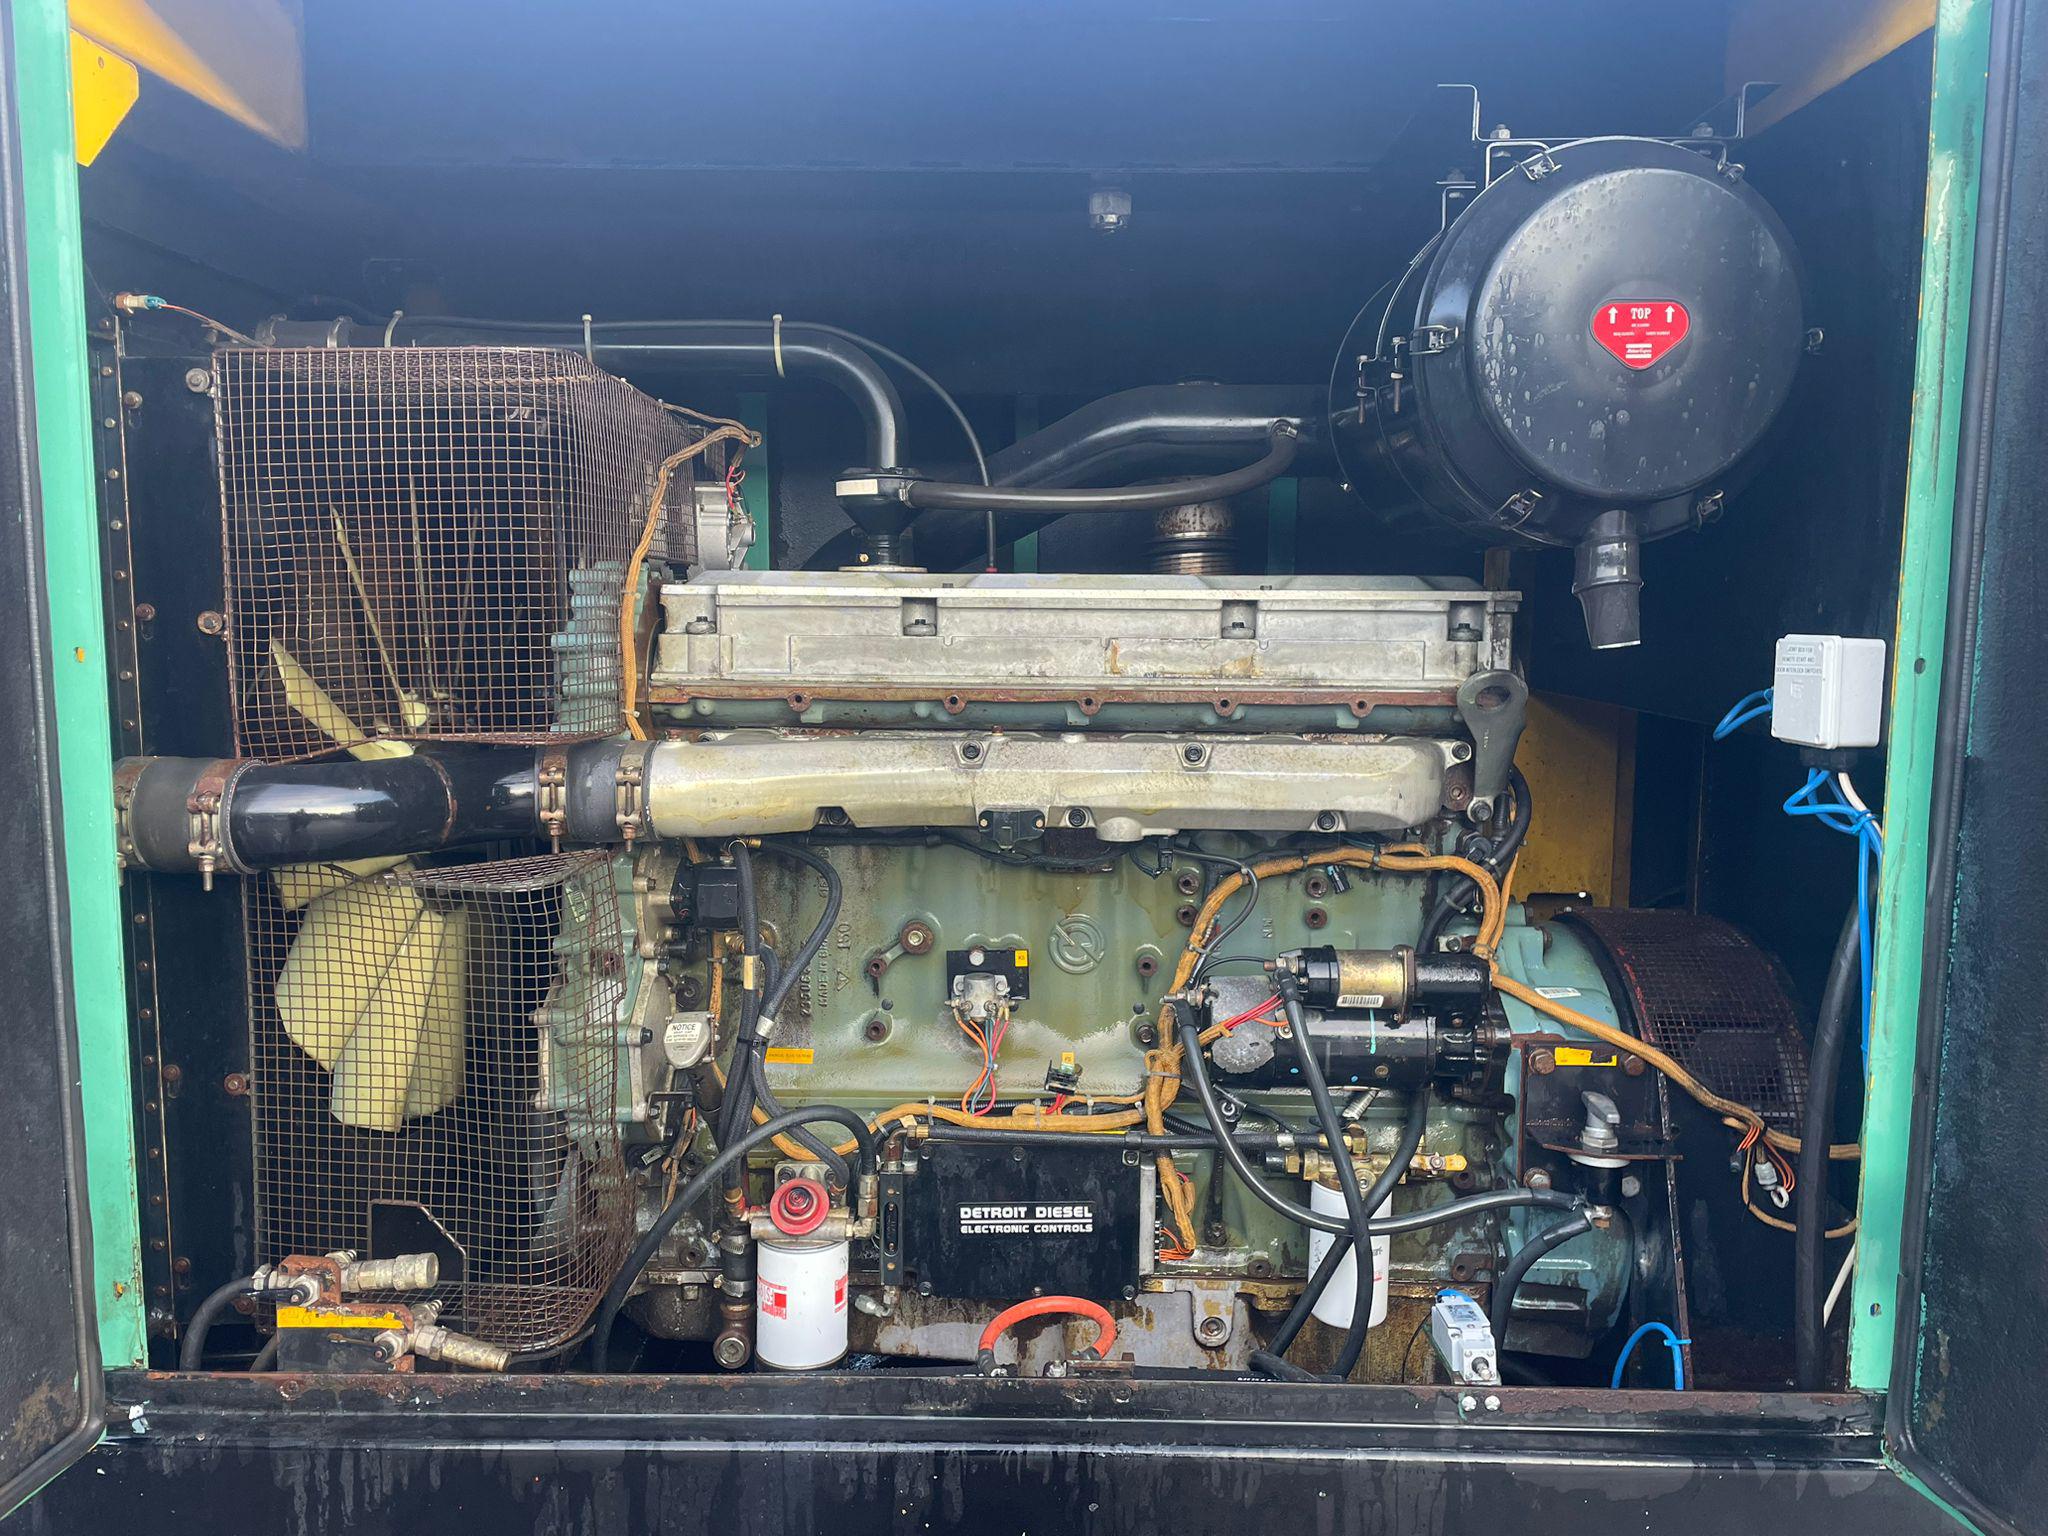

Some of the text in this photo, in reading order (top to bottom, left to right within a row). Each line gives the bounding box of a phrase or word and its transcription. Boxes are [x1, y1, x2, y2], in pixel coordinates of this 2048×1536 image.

[1630, 308, 1652, 319] TOP
[672, 1023, 696, 1031] NOTICE
[960, 1206, 1093, 1220] DETROIT DIESEL
[960, 1223, 1094, 1234] ELECTRONIC CONTROLS
